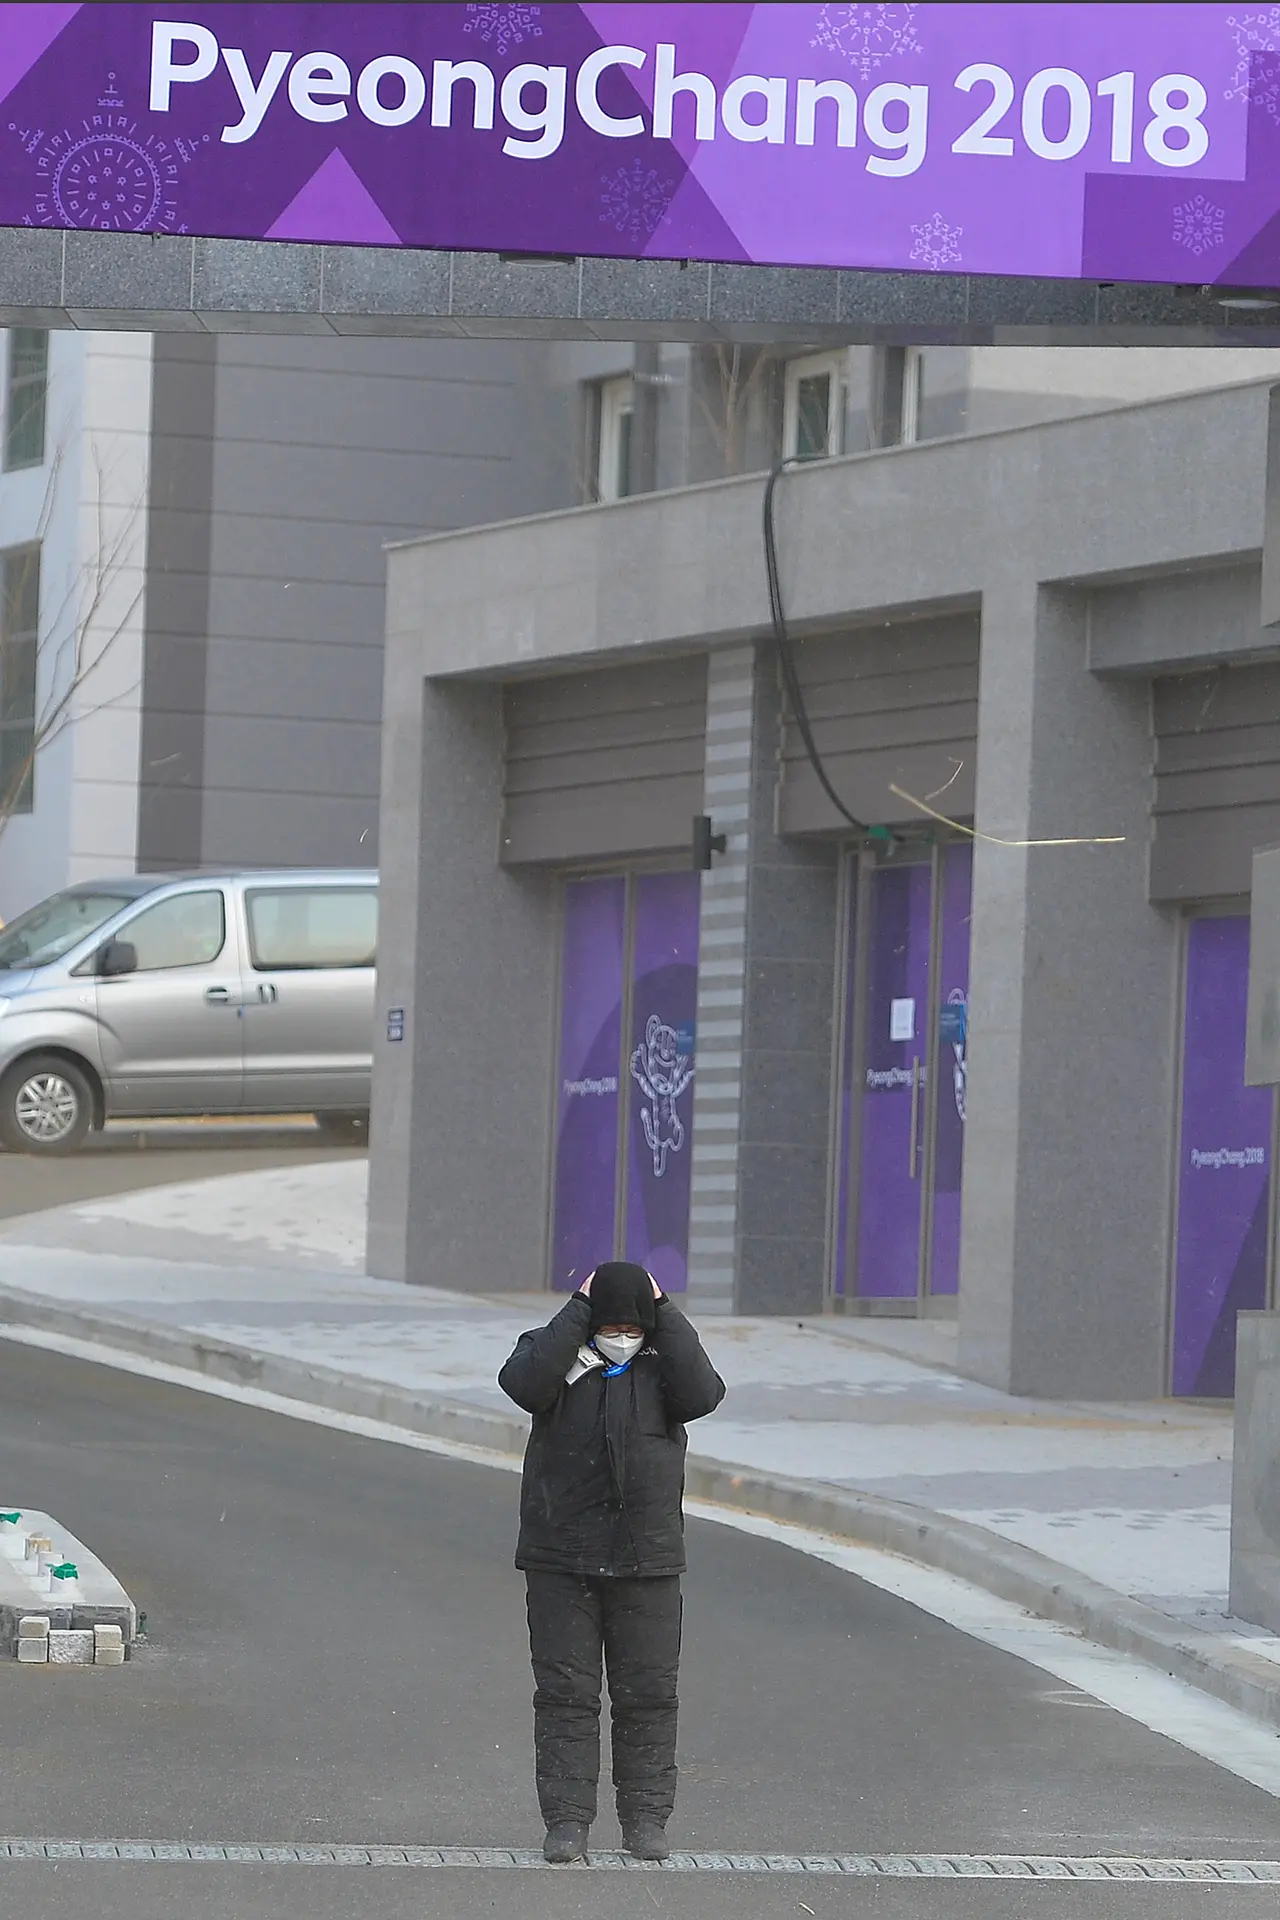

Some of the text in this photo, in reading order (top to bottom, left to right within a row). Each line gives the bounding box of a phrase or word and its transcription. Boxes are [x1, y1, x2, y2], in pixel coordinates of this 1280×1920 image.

[148, 20, 1210, 178] PyeongChang 2018
[1190, 1147, 1244, 1169] PyeongChang
